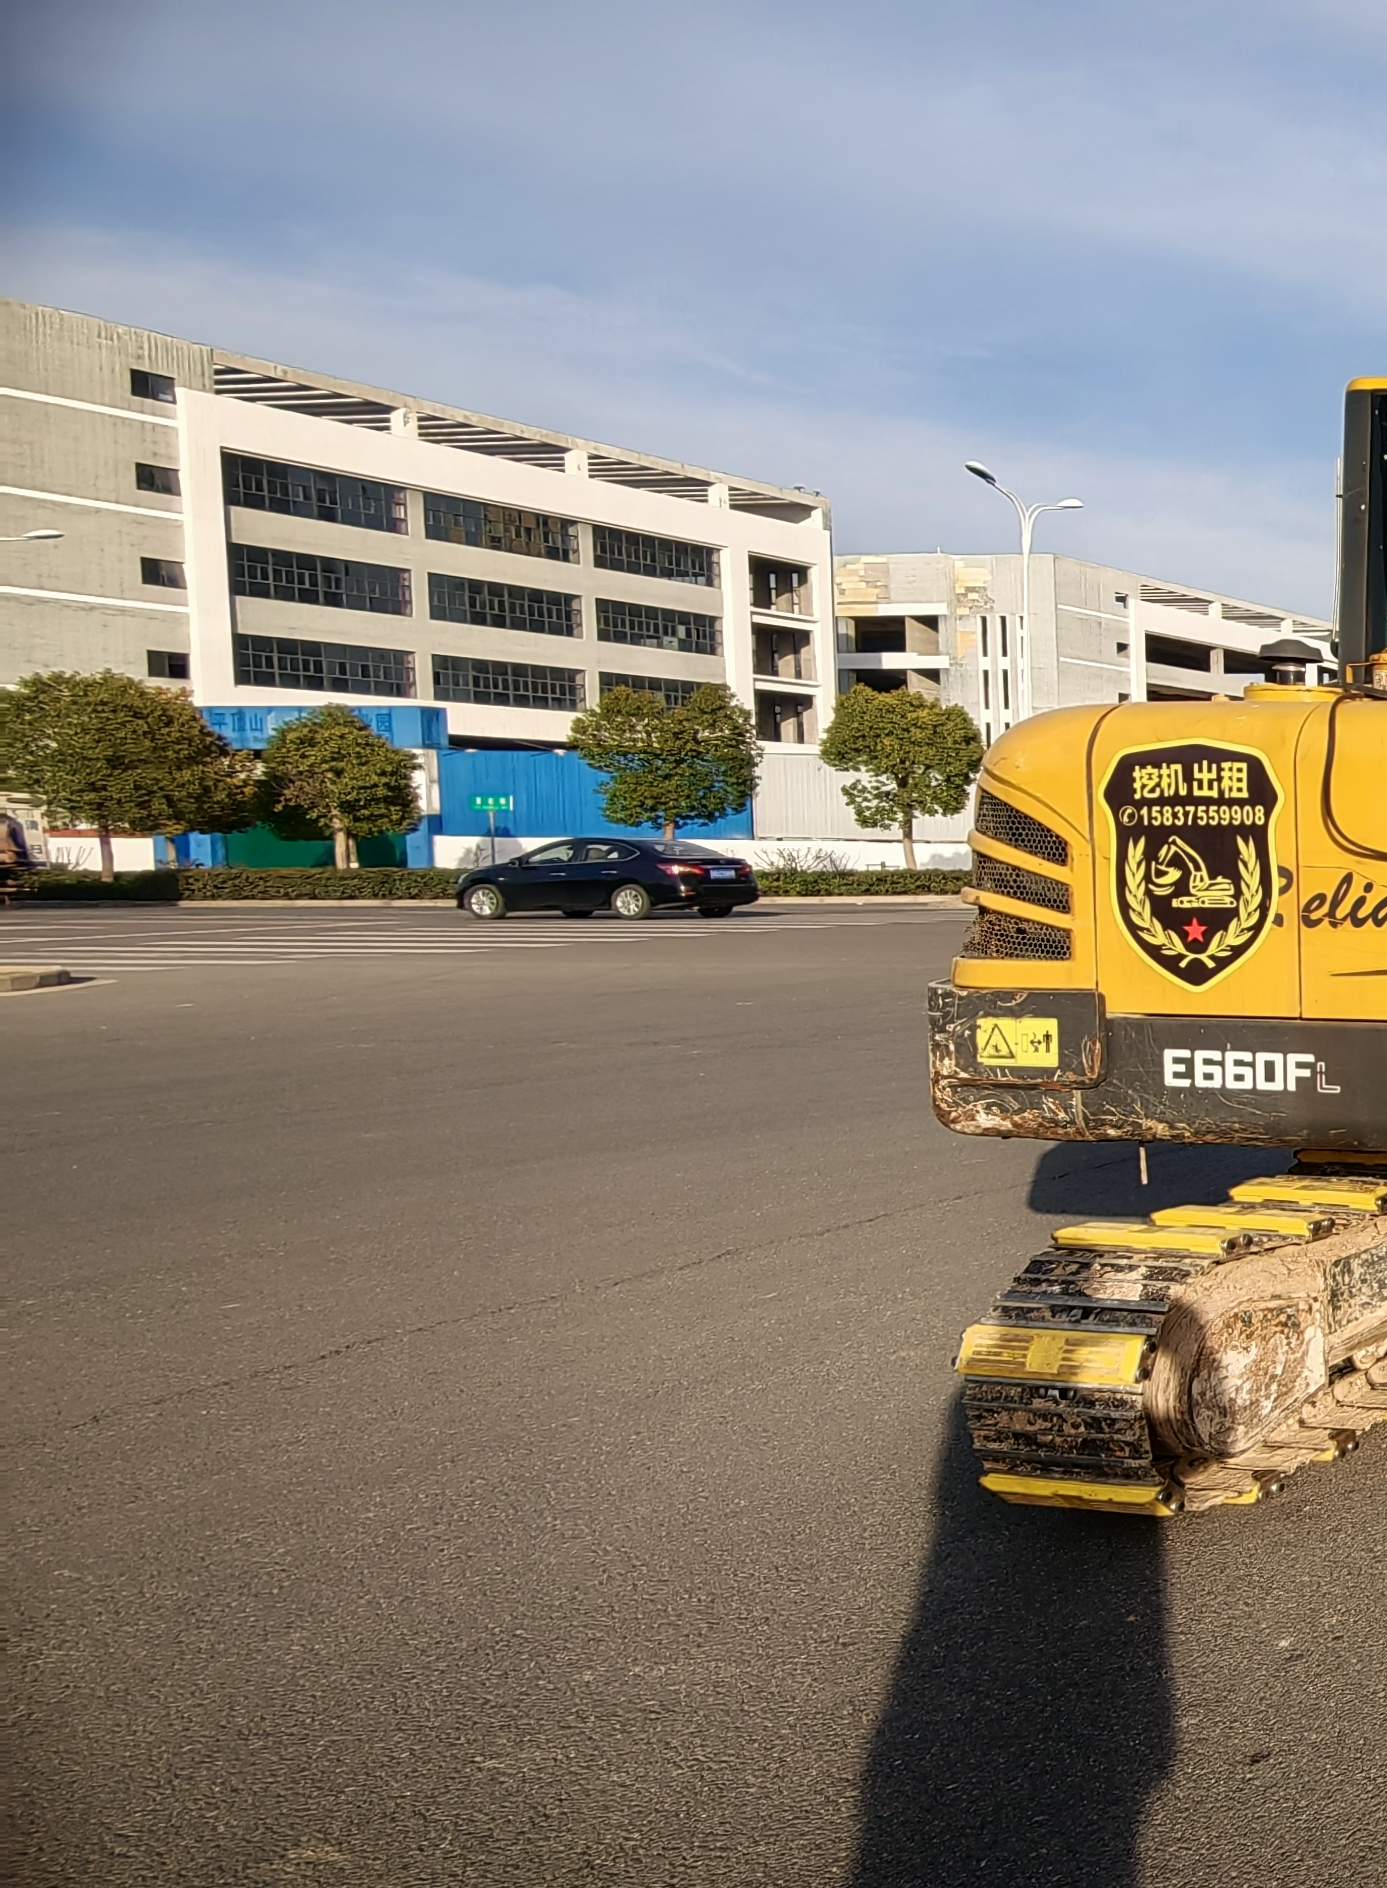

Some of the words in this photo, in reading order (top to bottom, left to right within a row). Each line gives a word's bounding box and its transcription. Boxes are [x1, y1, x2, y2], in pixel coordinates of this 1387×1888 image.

[1132, 762, 1187, 799] 挖机
[1193, 760, 1249, 798] 出租
[1140, 805, 1265, 826] 15837559908
